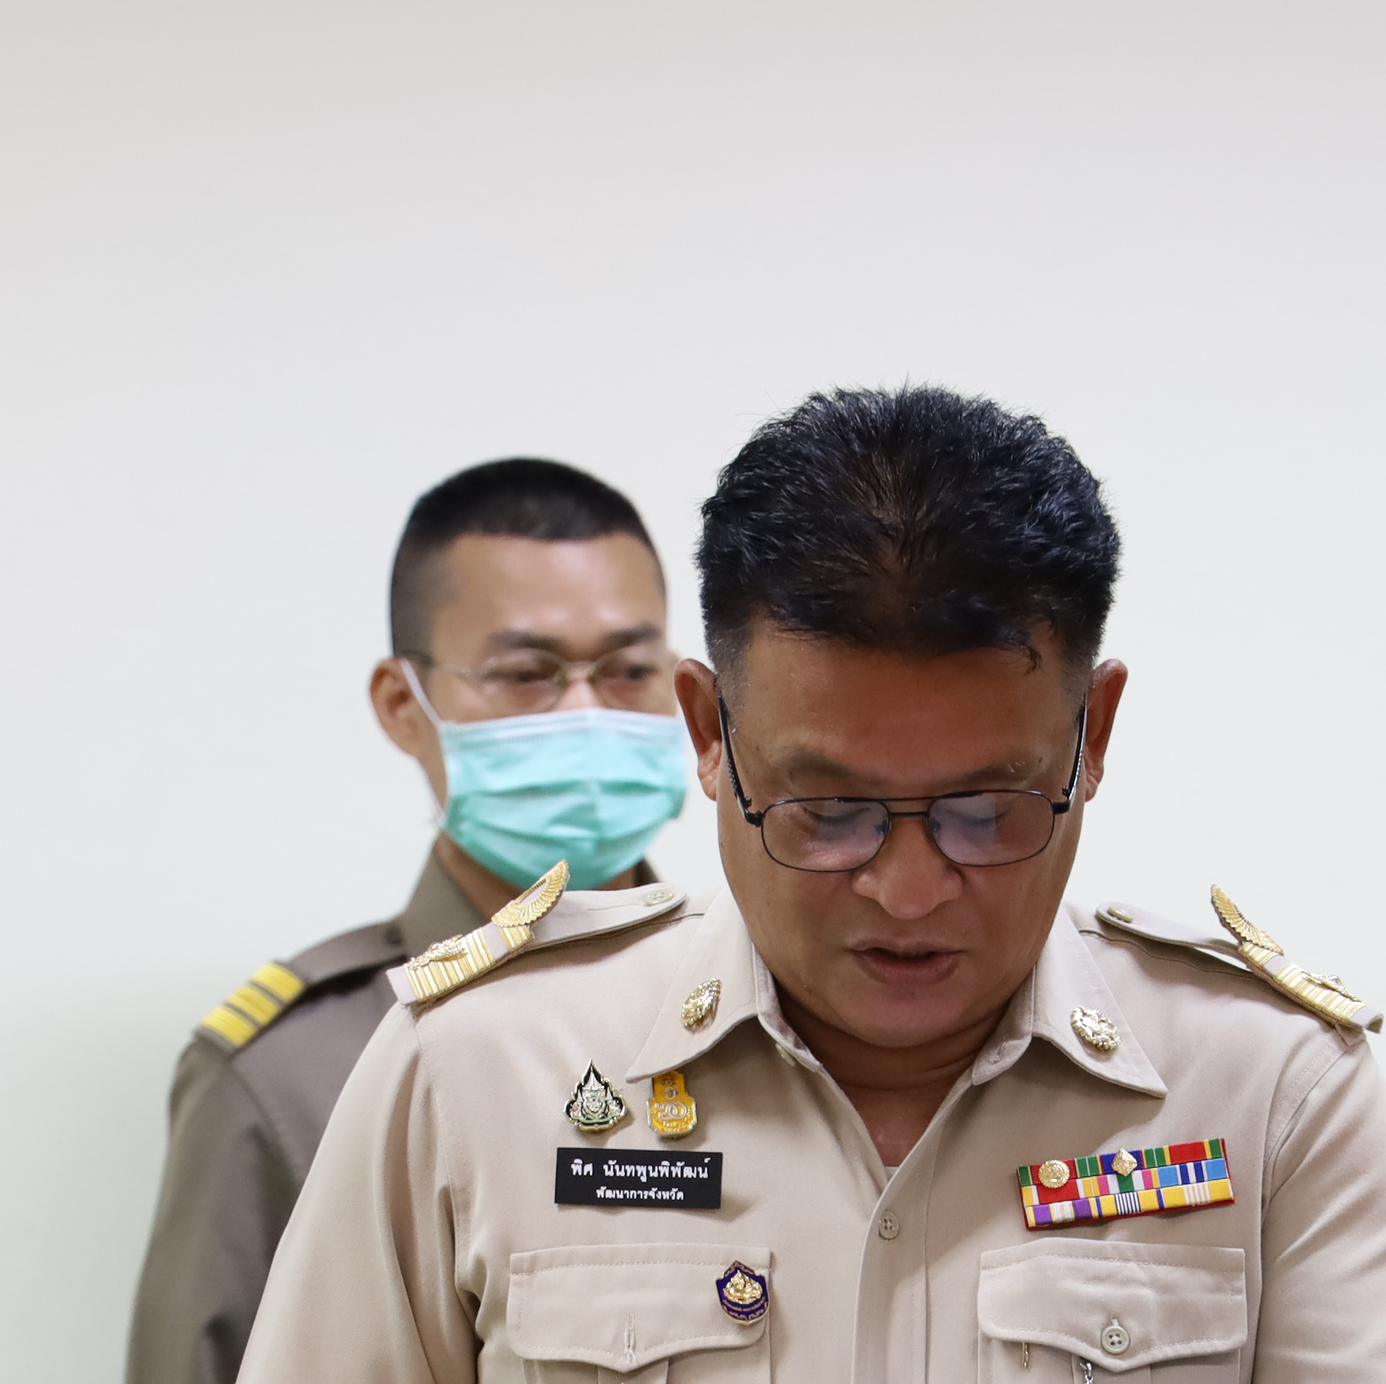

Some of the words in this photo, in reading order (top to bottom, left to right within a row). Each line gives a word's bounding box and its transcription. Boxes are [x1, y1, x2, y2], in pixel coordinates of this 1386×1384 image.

[570, 1158, 594, 1177] พิศ
[602, 1157, 712, 1183] นันทพูนพิพัฒน์
[595, 1186, 685, 1201] พัฒนาการจังหวัด
